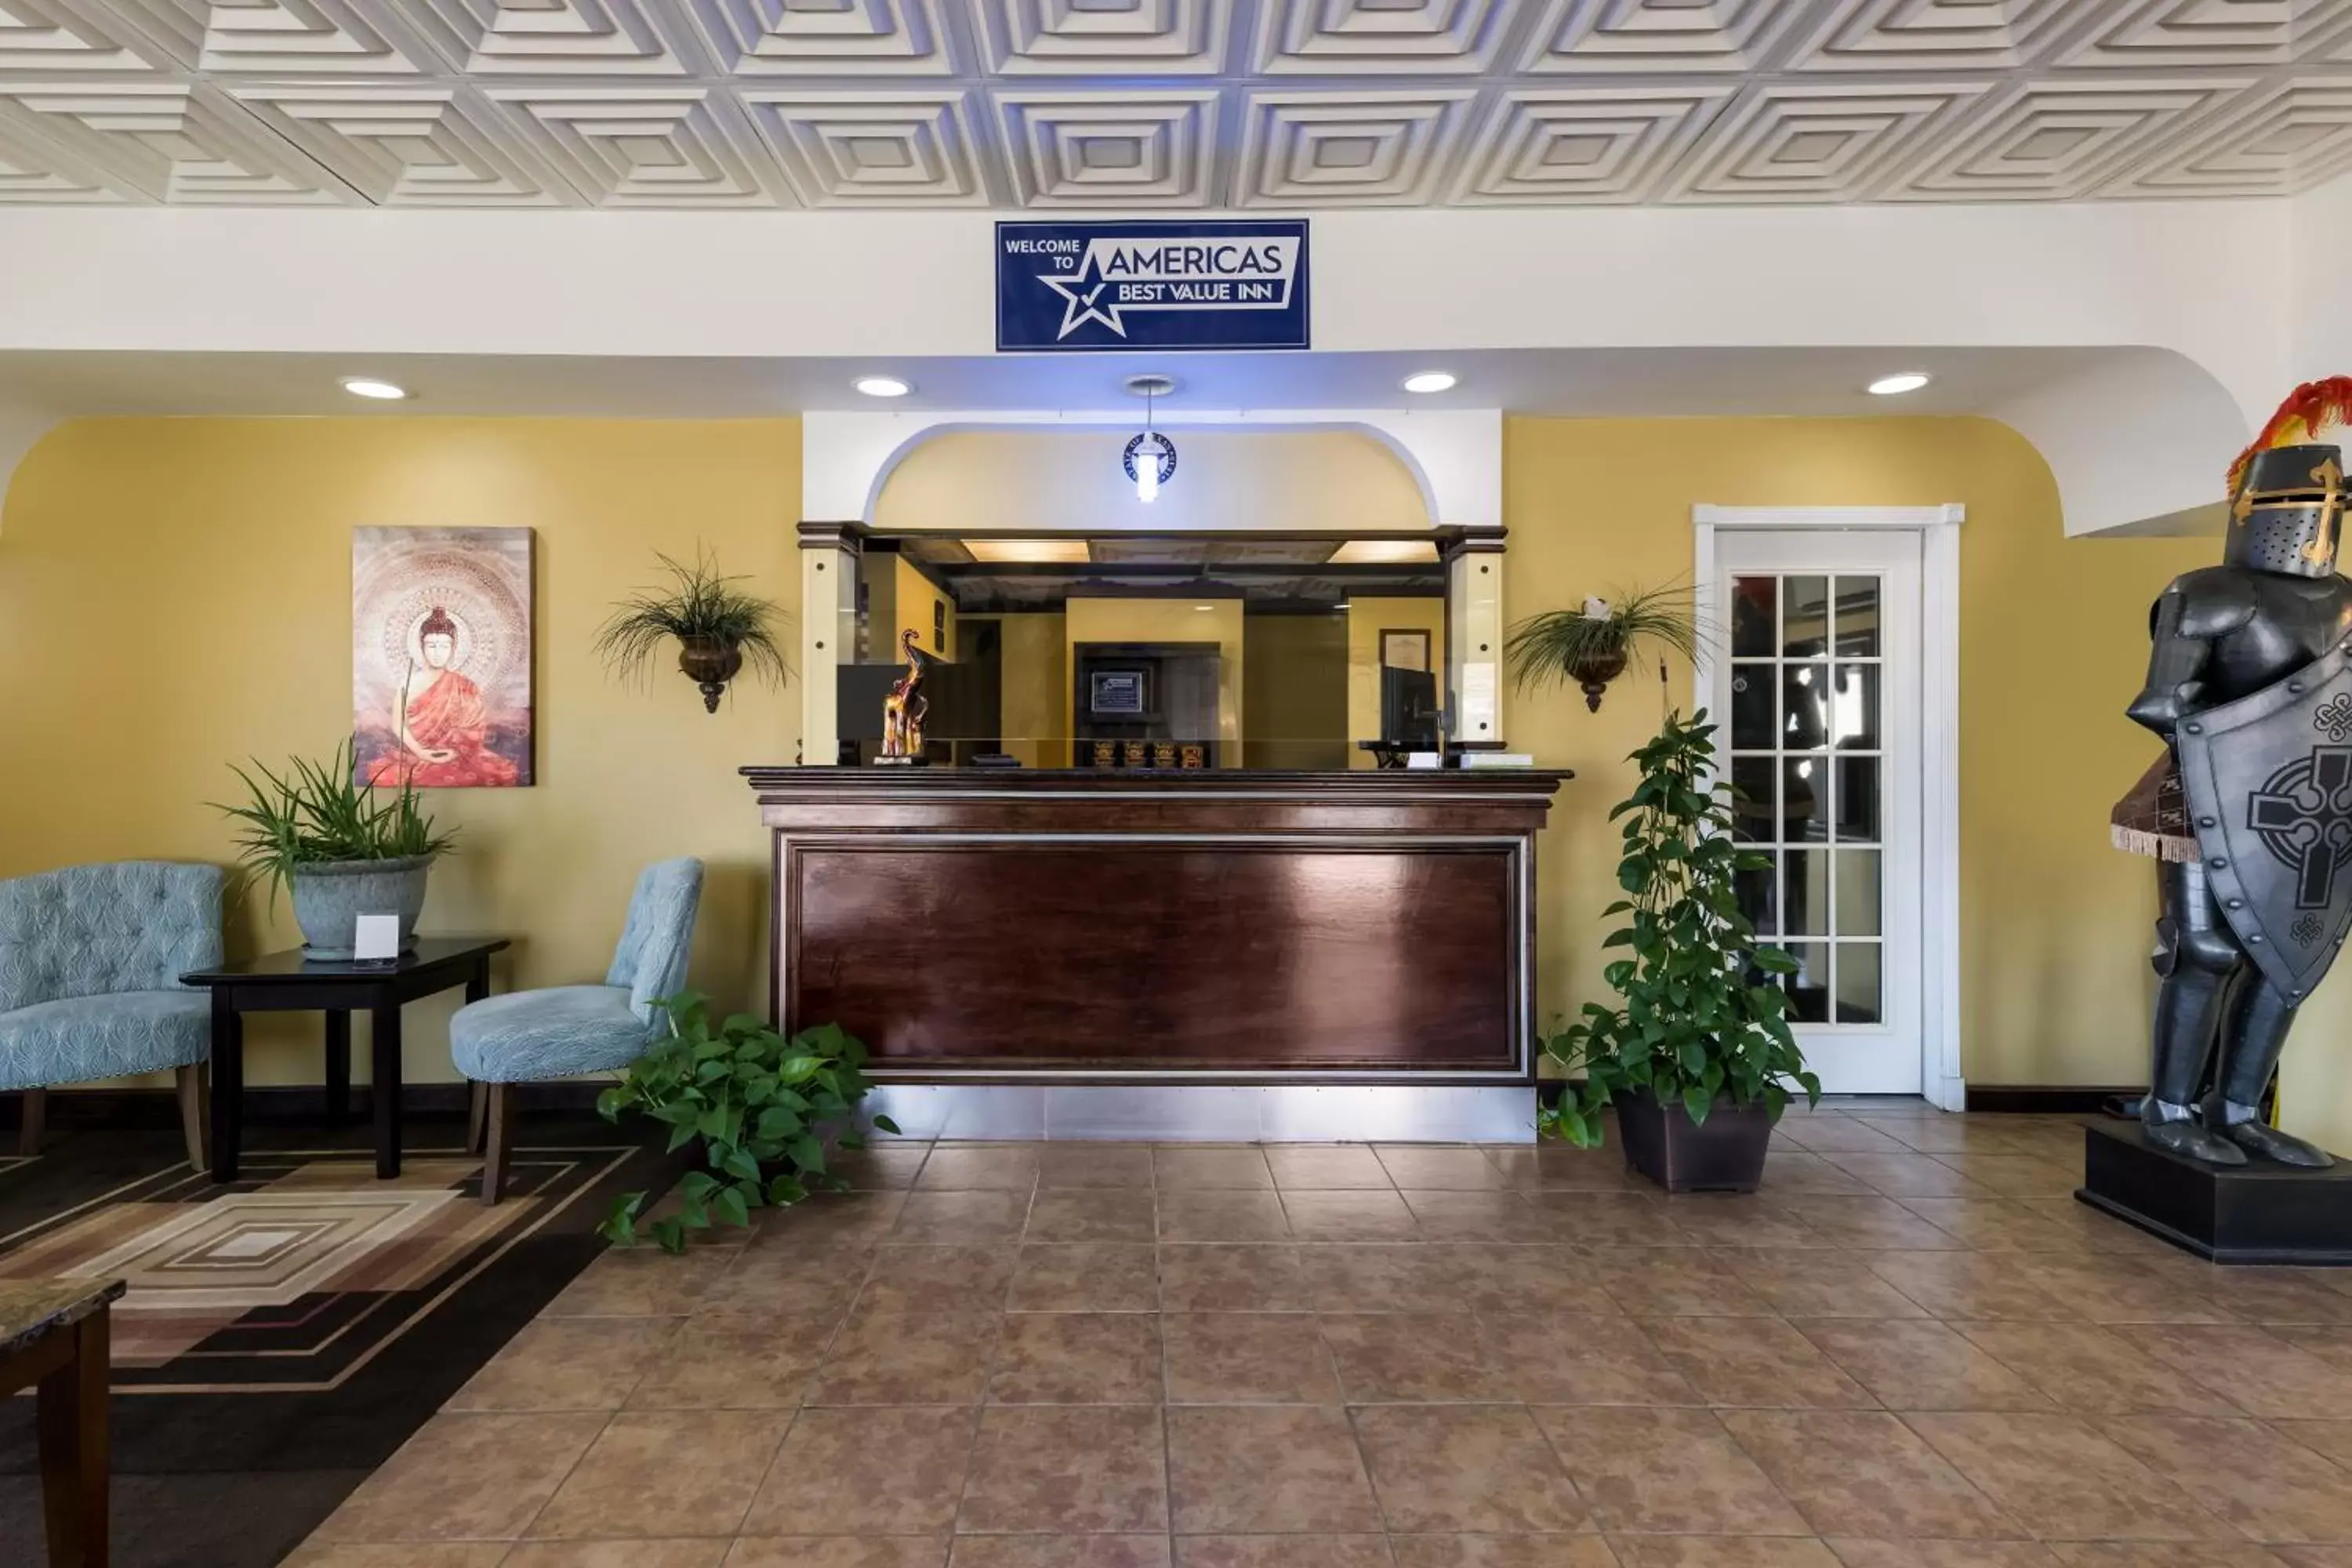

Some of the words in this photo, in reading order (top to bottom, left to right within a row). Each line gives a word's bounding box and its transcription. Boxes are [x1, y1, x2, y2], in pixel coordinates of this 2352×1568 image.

[1005, 239, 1080, 253] WELCOME
[1053, 256, 1074, 269] TO
[1105, 245, 1282, 274] AMERICAS
[1119, 283, 1166, 301] BEST
[1169, 283, 1230, 301] VALUE
[1238, 283, 1272, 300] INN
